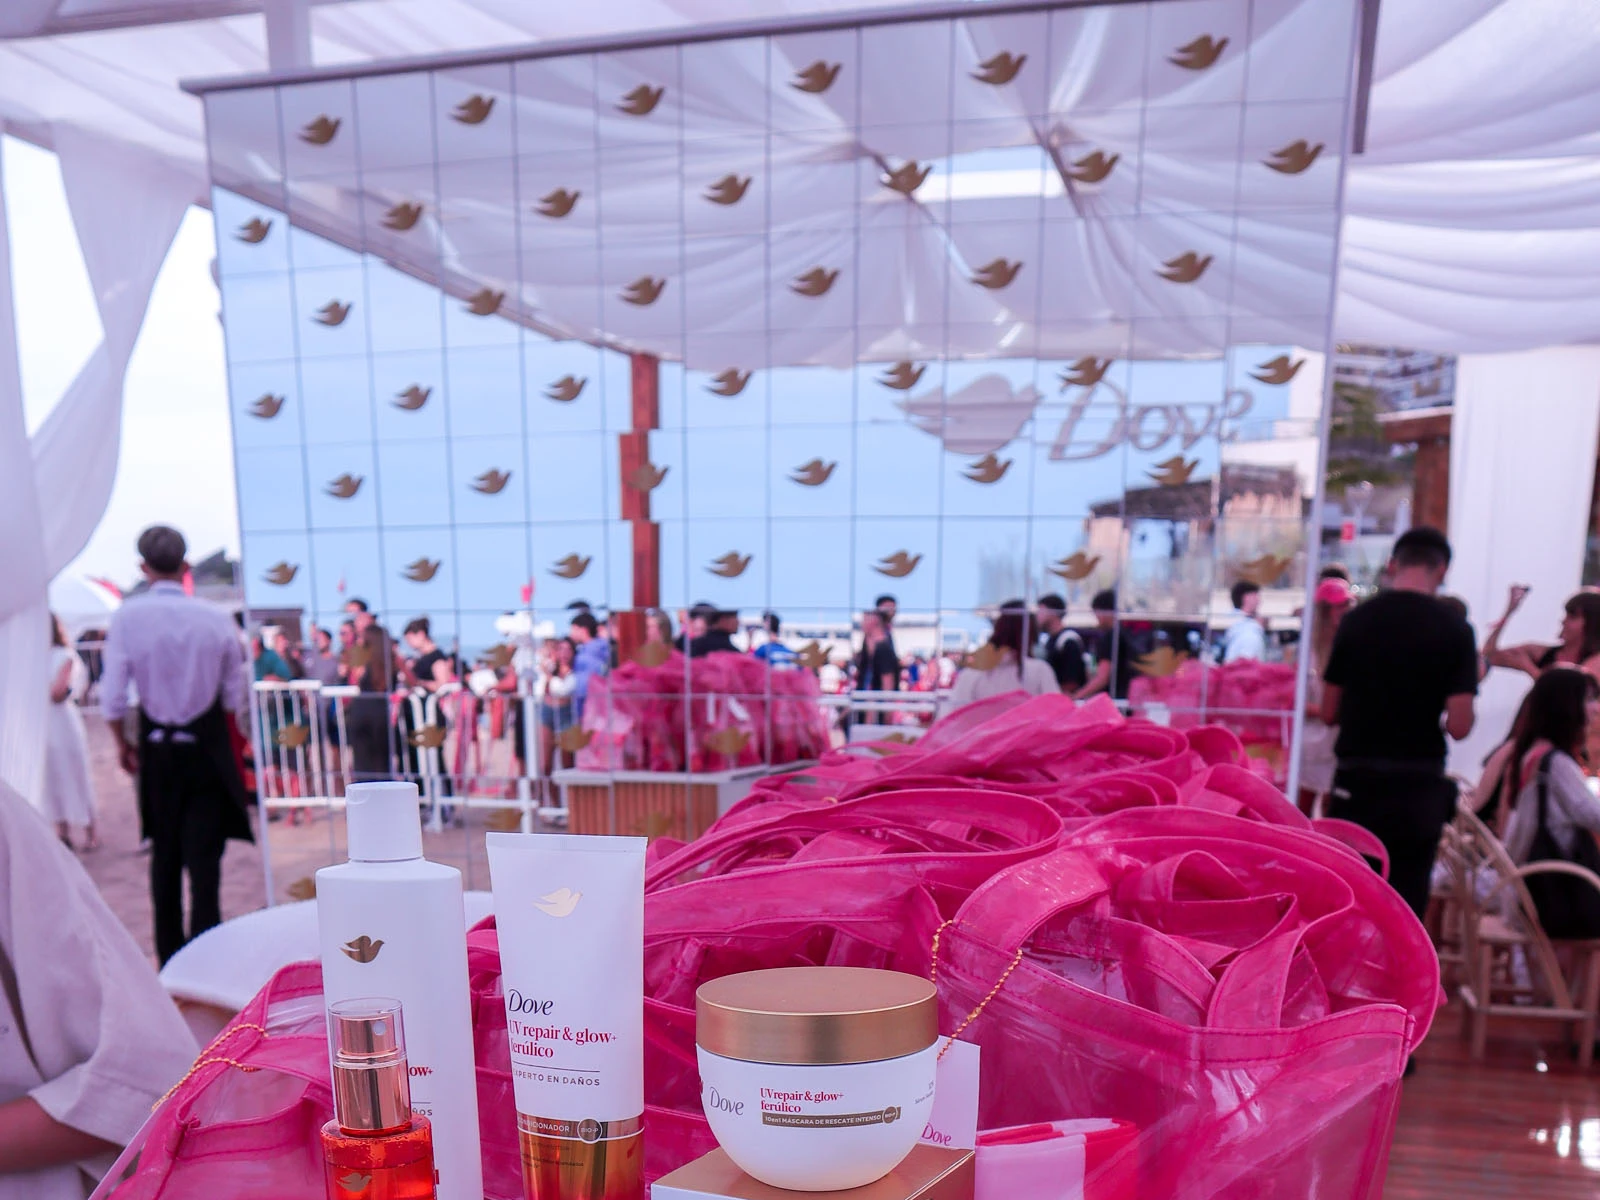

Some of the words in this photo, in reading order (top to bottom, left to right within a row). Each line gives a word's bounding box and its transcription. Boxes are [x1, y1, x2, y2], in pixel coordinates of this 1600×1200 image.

[1048, 379, 1255, 461] Dove
[508, 988, 554, 1016] Dove
[509, 1019, 522, 1035] UV
[523, 1024, 560, 1041] repair
[562, 1026, 574, 1041] &
[547, 1075, 560, 1084] EN
[562, 1076, 600, 1087] DAÑOS
[709, 1086, 744, 1116] Dove
[760, 1087, 774, 1098] UV
[773, 1090, 804, 1102] repair
[804, 1090, 813, 1101] &
[760, 1099, 802, 1113] ferúlico
[782, 1117, 814, 1125] MÁSCARA
[855, 1114, 882, 1122] INTENSO
[921, 1122, 952, 1147] Dove
